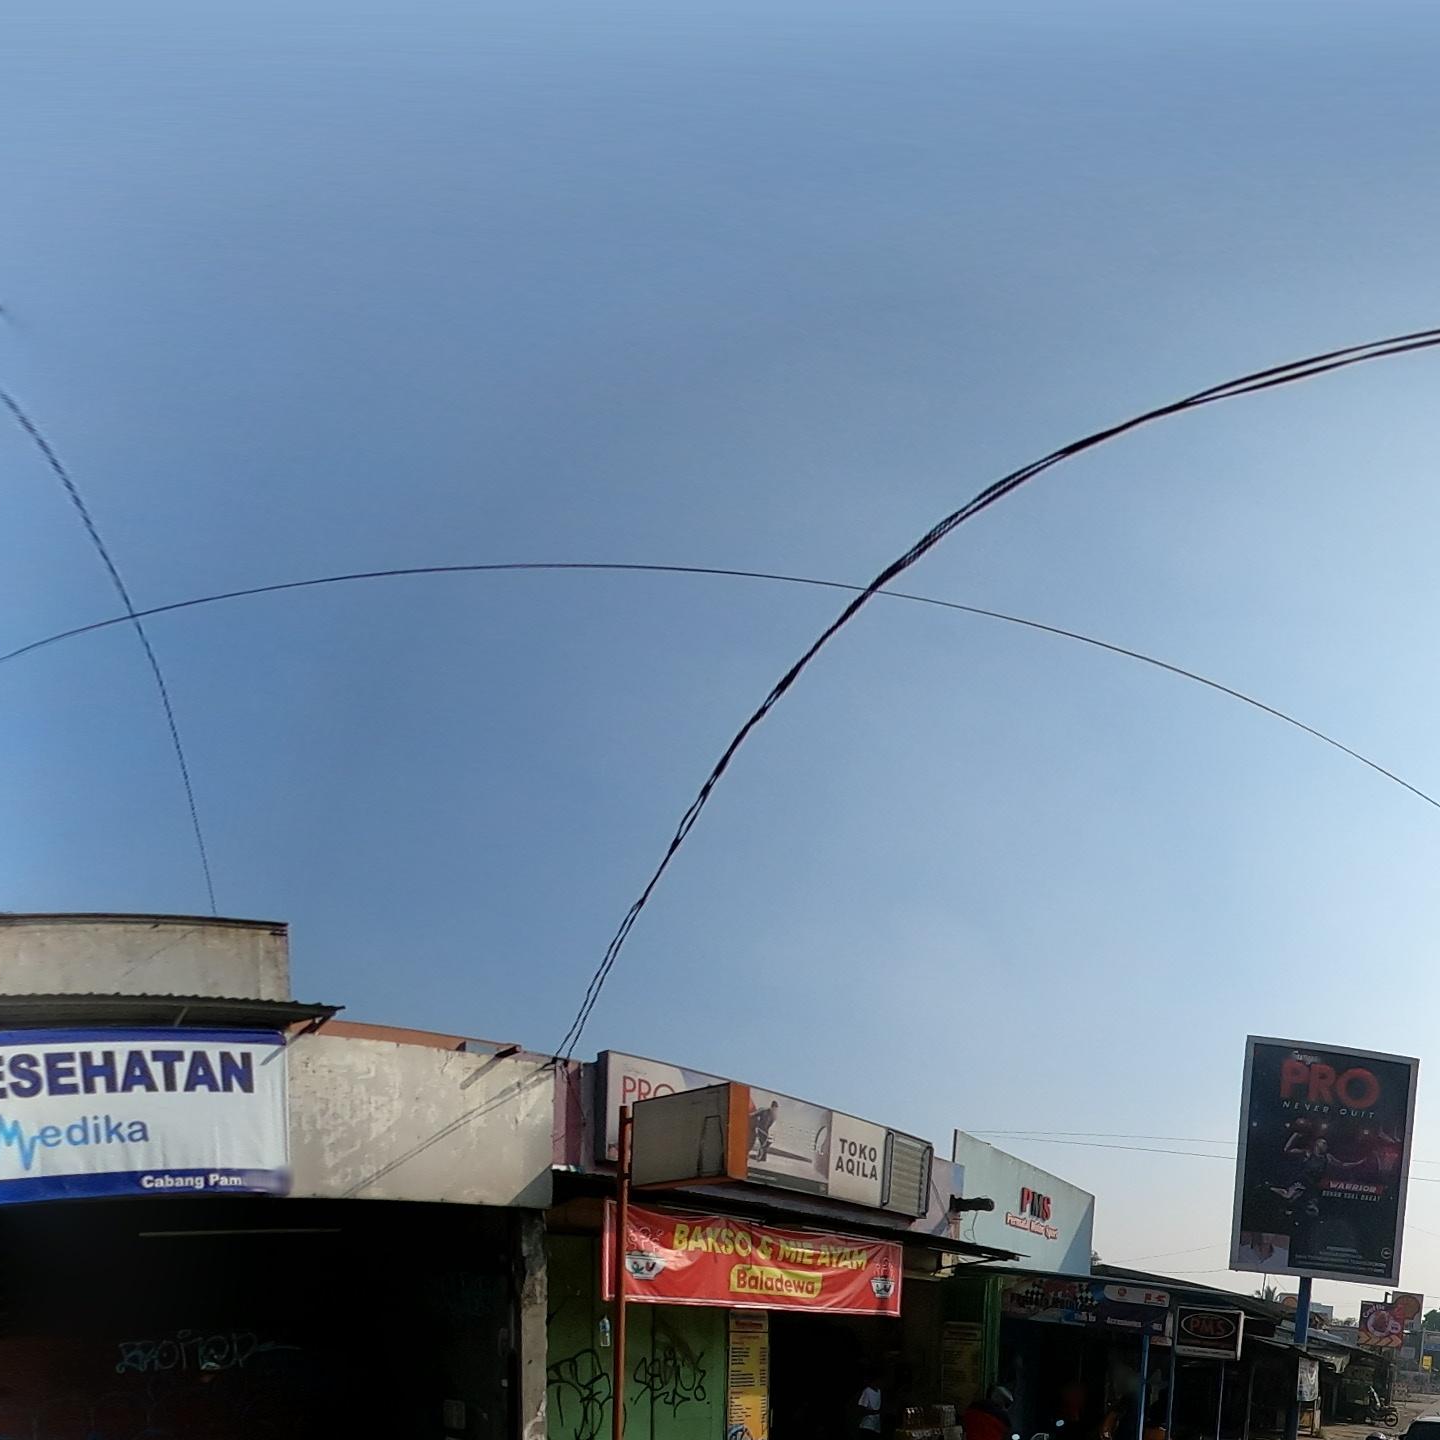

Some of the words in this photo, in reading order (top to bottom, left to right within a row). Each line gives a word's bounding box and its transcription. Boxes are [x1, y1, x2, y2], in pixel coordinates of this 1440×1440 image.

[1280, 1058, 1379, 1110] PRO
[1282, 1101, 1330, 1113] NEVER
[839, 1138, 879, 1163] TOKO
[835, 1158, 879, 1181] AQILA
[141, 1175, 204, 1189] Cabang
[1329, 1181, 1378, 1193] WARRIOR
[1020, 1187, 1051, 1222] PMS
[673, 1223, 753, 1257] BAKSO
[758, 1236, 773, 1260] &
[778, 1239, 815, 1266] MIE
[816, 1242, 870, 1271] AYAM
[736, 1269, 816, 1295] Baladewa
[1189, 1318, 1226, 1336] PMS
